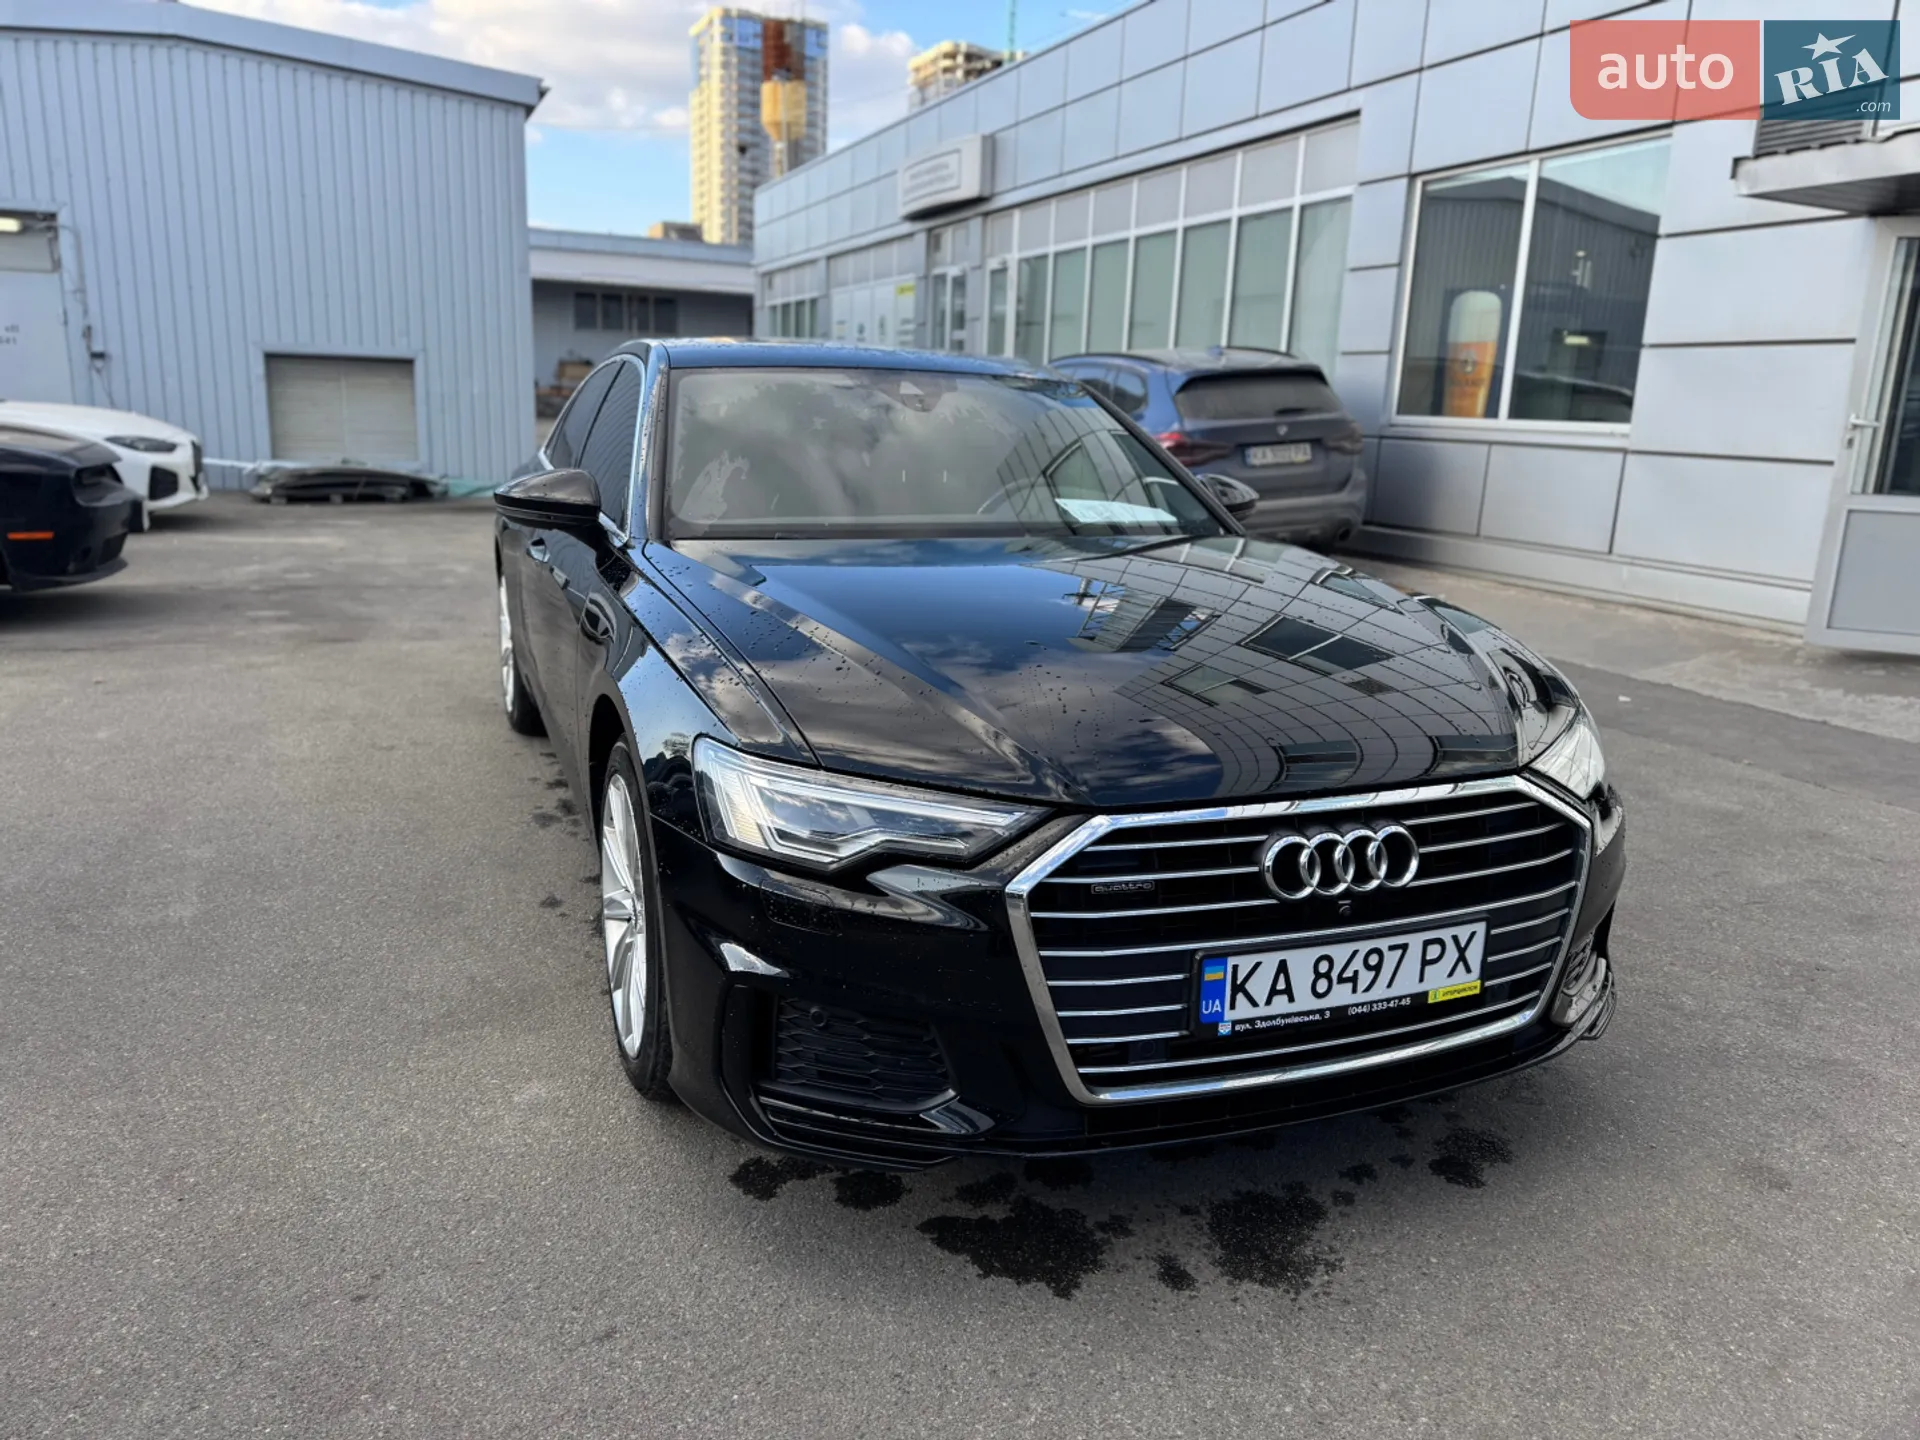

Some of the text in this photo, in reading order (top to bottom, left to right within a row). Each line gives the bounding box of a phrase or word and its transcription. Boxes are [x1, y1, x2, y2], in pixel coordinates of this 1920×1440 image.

[1229, 930, 1478, 1011] KA 8497 PX
[1202, 998, 1222, 1014] UA
[1323, 1010, 1331, 1019] 3
[1347, 997, 1412, 1016] (044) 333-47-45
